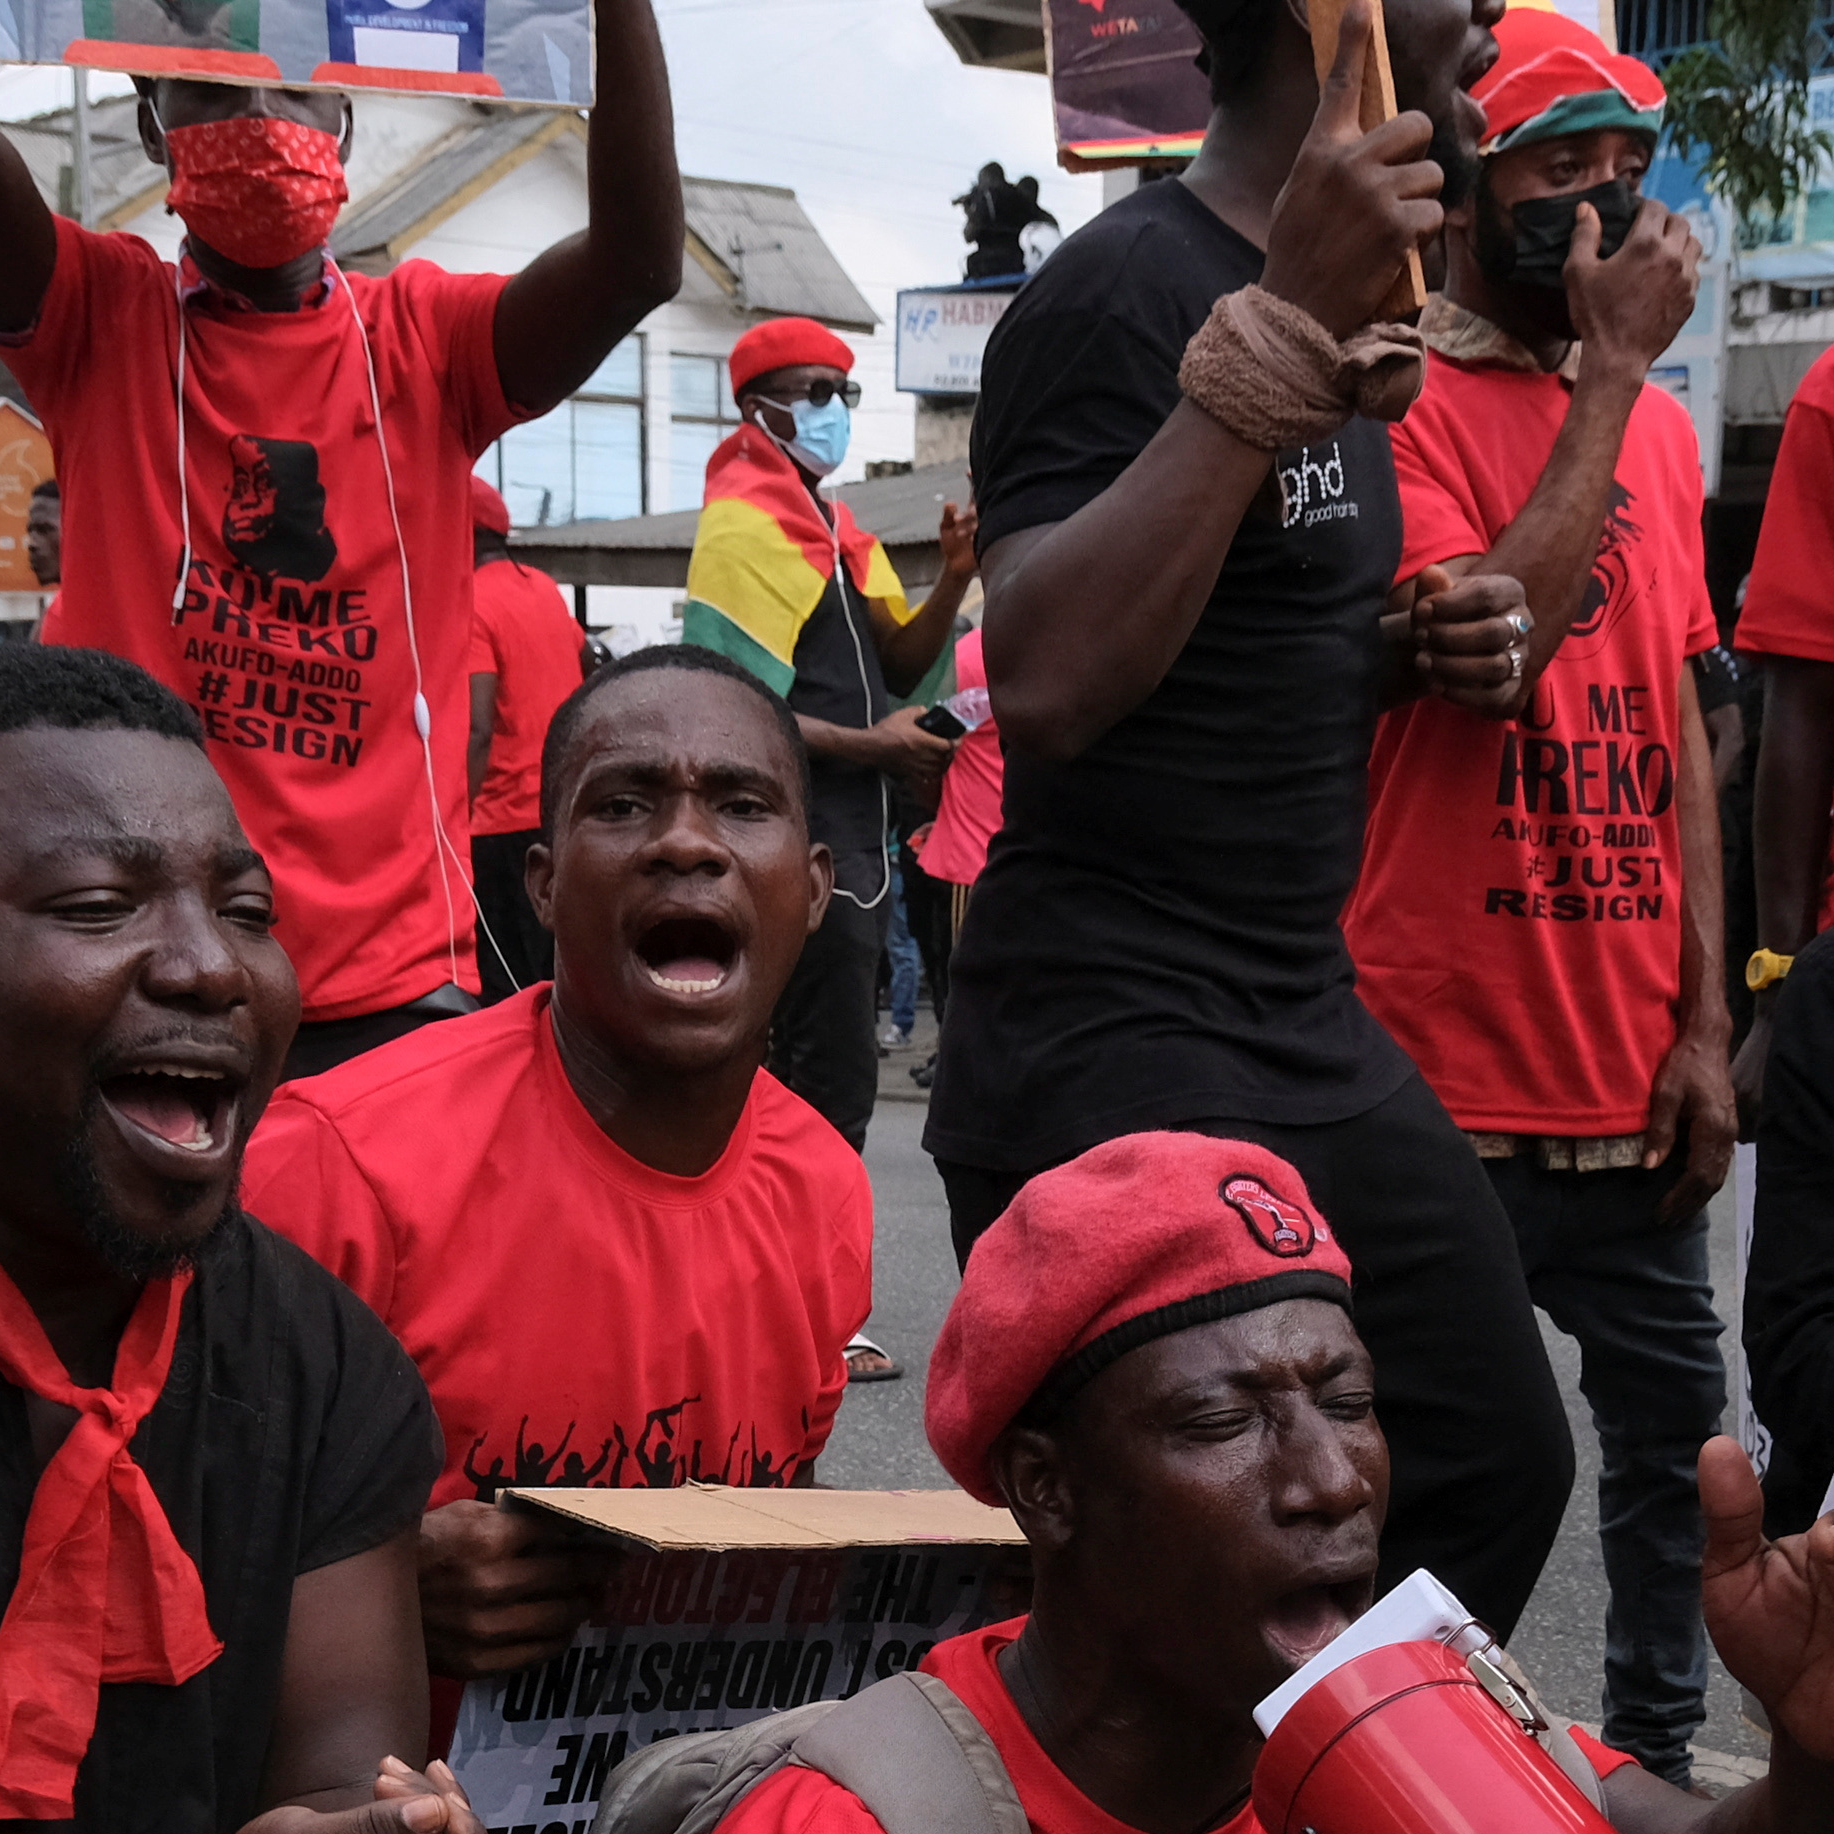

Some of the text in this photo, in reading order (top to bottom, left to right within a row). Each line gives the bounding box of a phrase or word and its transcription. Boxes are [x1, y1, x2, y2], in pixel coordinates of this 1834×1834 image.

[175, 588, 378, 662] PREKO
[276, 583, 372, 628] ME
[183, 636, 362, 694] AKUFO-ADDO
[196, 670, 372, 732] #JUST
[1587, 683, 1649, 736] ME
[1527, 855, 1663, 889] #JUST
[1484, 887, 1663, 922] RESIGN
[845, 1553, 941, 1625] THE
[543, 1729, 629, 1807] WE
